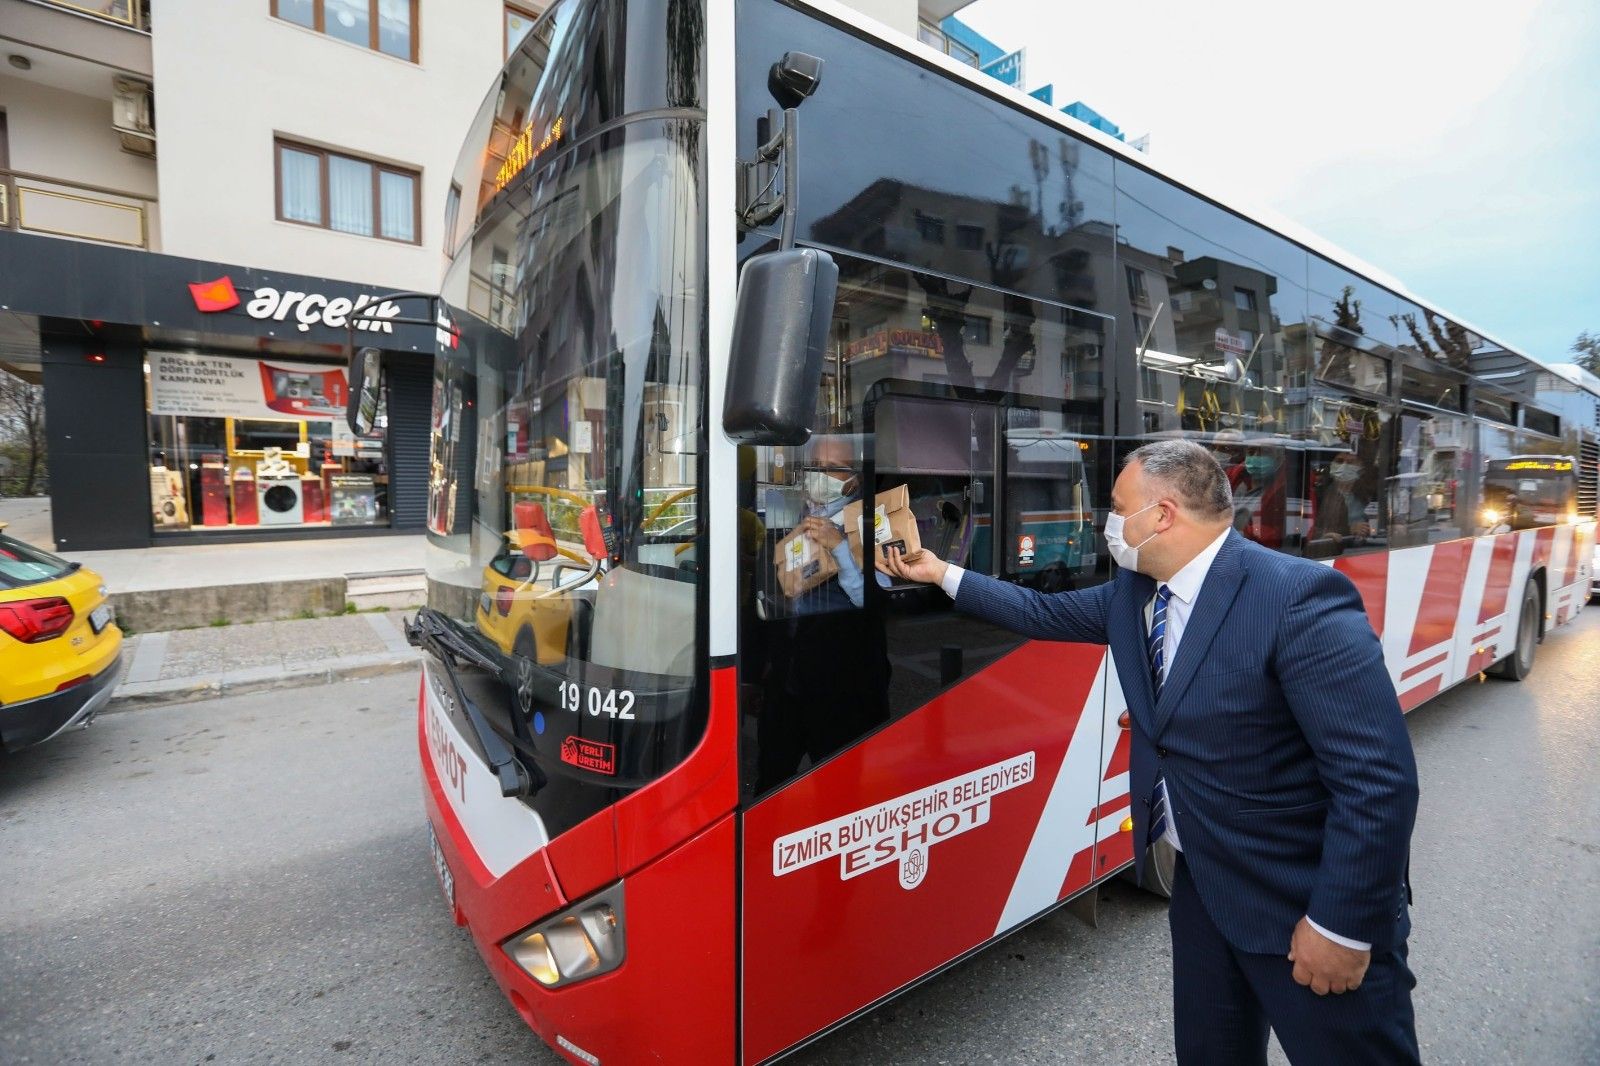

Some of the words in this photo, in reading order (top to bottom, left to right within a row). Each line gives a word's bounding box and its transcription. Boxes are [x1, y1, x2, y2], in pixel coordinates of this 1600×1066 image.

[160, 365, 190, 374] DÖRT
[194, 368, 245, 378] DÖRTLÜK
[558, 680, 580, 712] 19
[588, 687, 635, 720] 042
[578, 754, 611, 770] ÜRETİM
[579, 744, 604, 757] YERLİ
[778, 830, 833, 870] İZMİR
[838, 787, 948, 849] BÜYÜKŞEHİR
[953, 755, 1033, 805] BELEDİYESİ
[845, 800, 988, 875] ESHOT
